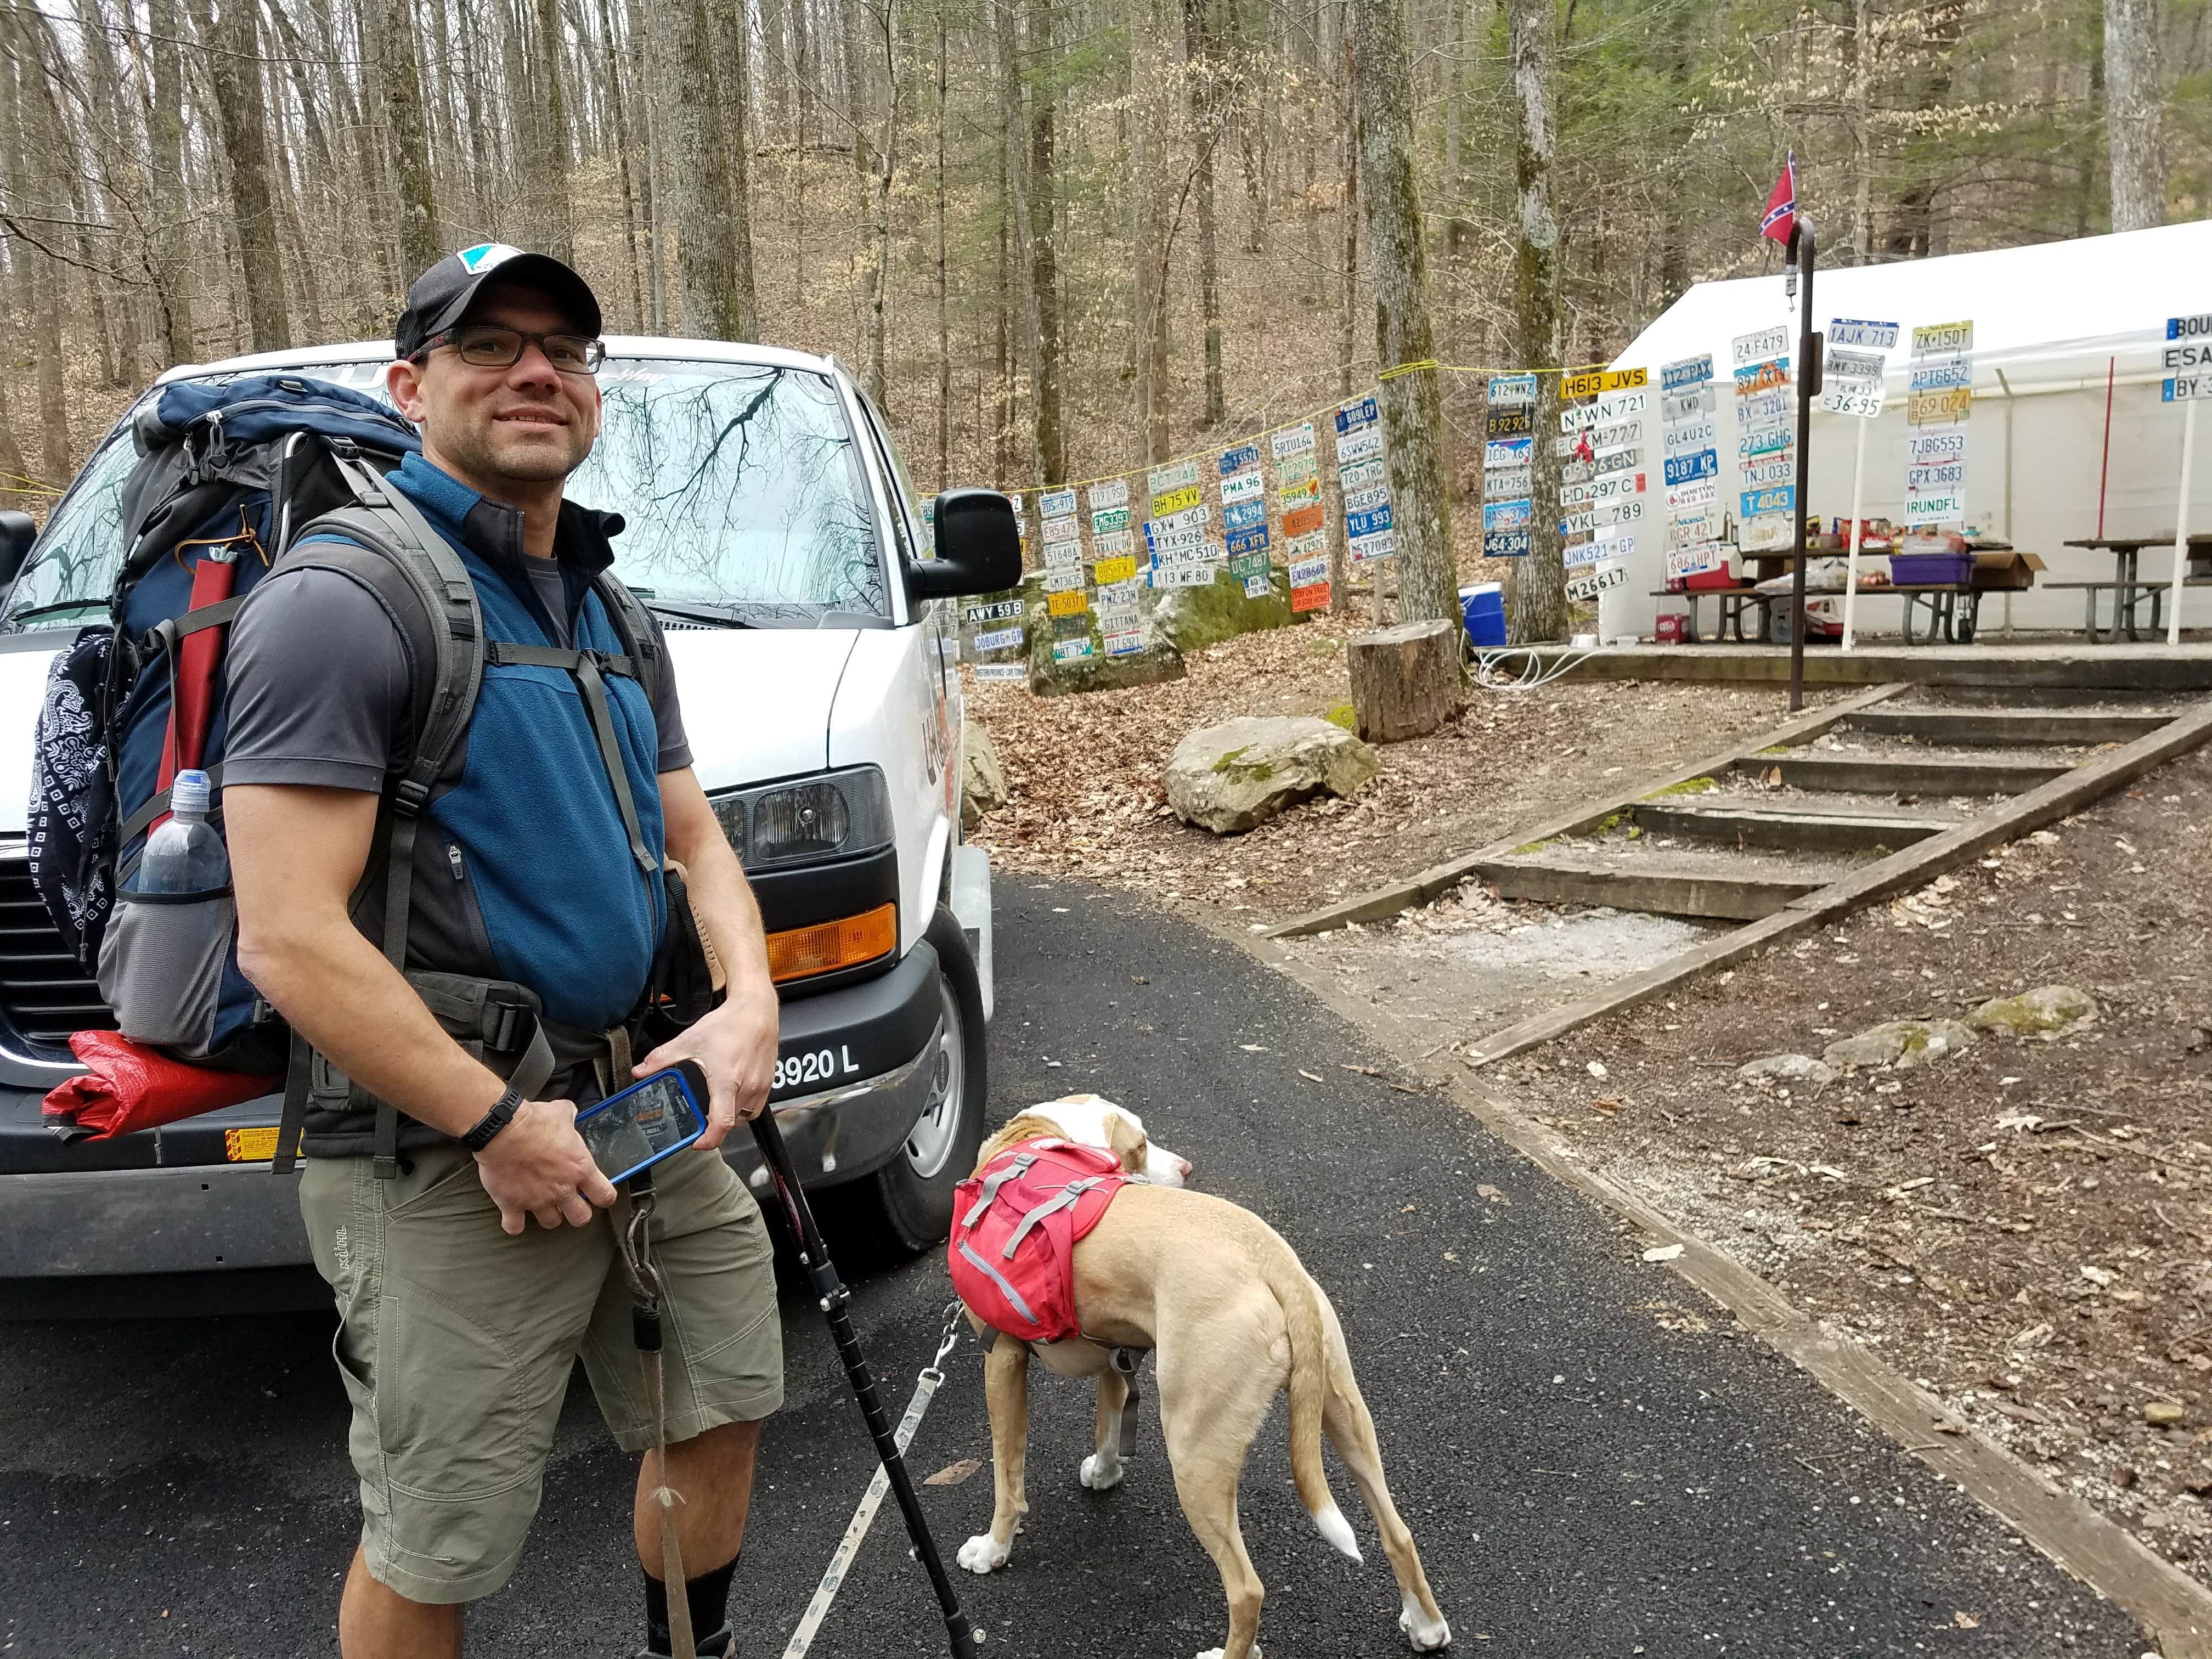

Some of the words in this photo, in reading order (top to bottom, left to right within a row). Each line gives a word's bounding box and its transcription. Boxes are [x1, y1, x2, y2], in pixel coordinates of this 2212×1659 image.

[2177, 316, 2212, 336] BOU
[1565, 376, 1601, 395] H613
[1611, 370, 1643, 388] JVS
[2177, 379, 2198, 397] BY
[1618, 394, 1644, 414] 721
[1740, 434, 1763, 453] 273
[1769, 463, 1791, 479] 033
[1933, 466, 1962, 483] 3683
[1246, 476, 1260, 489] 96
[1590, 481, 1617, 499] 297
[1622, 478, 1632, 493] C
[1154, 498, 1167, 513] BH
[1170, 494, 1182, 509] 75
[1183, 508, 1206, 526] 903
[1349, 516, 1367, 532] YLU
[1371, 510, 1390, 526] 993
[1568, 512, 1601, 531] YKL
[1612, 503, 1641, 523] 789
[1619, 537, 1634, 553] GP
[1158, 552, 1173, 567] KH
[1195, 569, 1208, 582] 80
[1567, 568, 1624, 601] M26617
[969, 606, 993, 622] AWY
[976, 633, 1006, 650] JOBURG
[1011, 630, 1022, 642] GP
[841, 1044, 859, 1073] L
[674, 1095, 687, 1114] SAMSUNG
